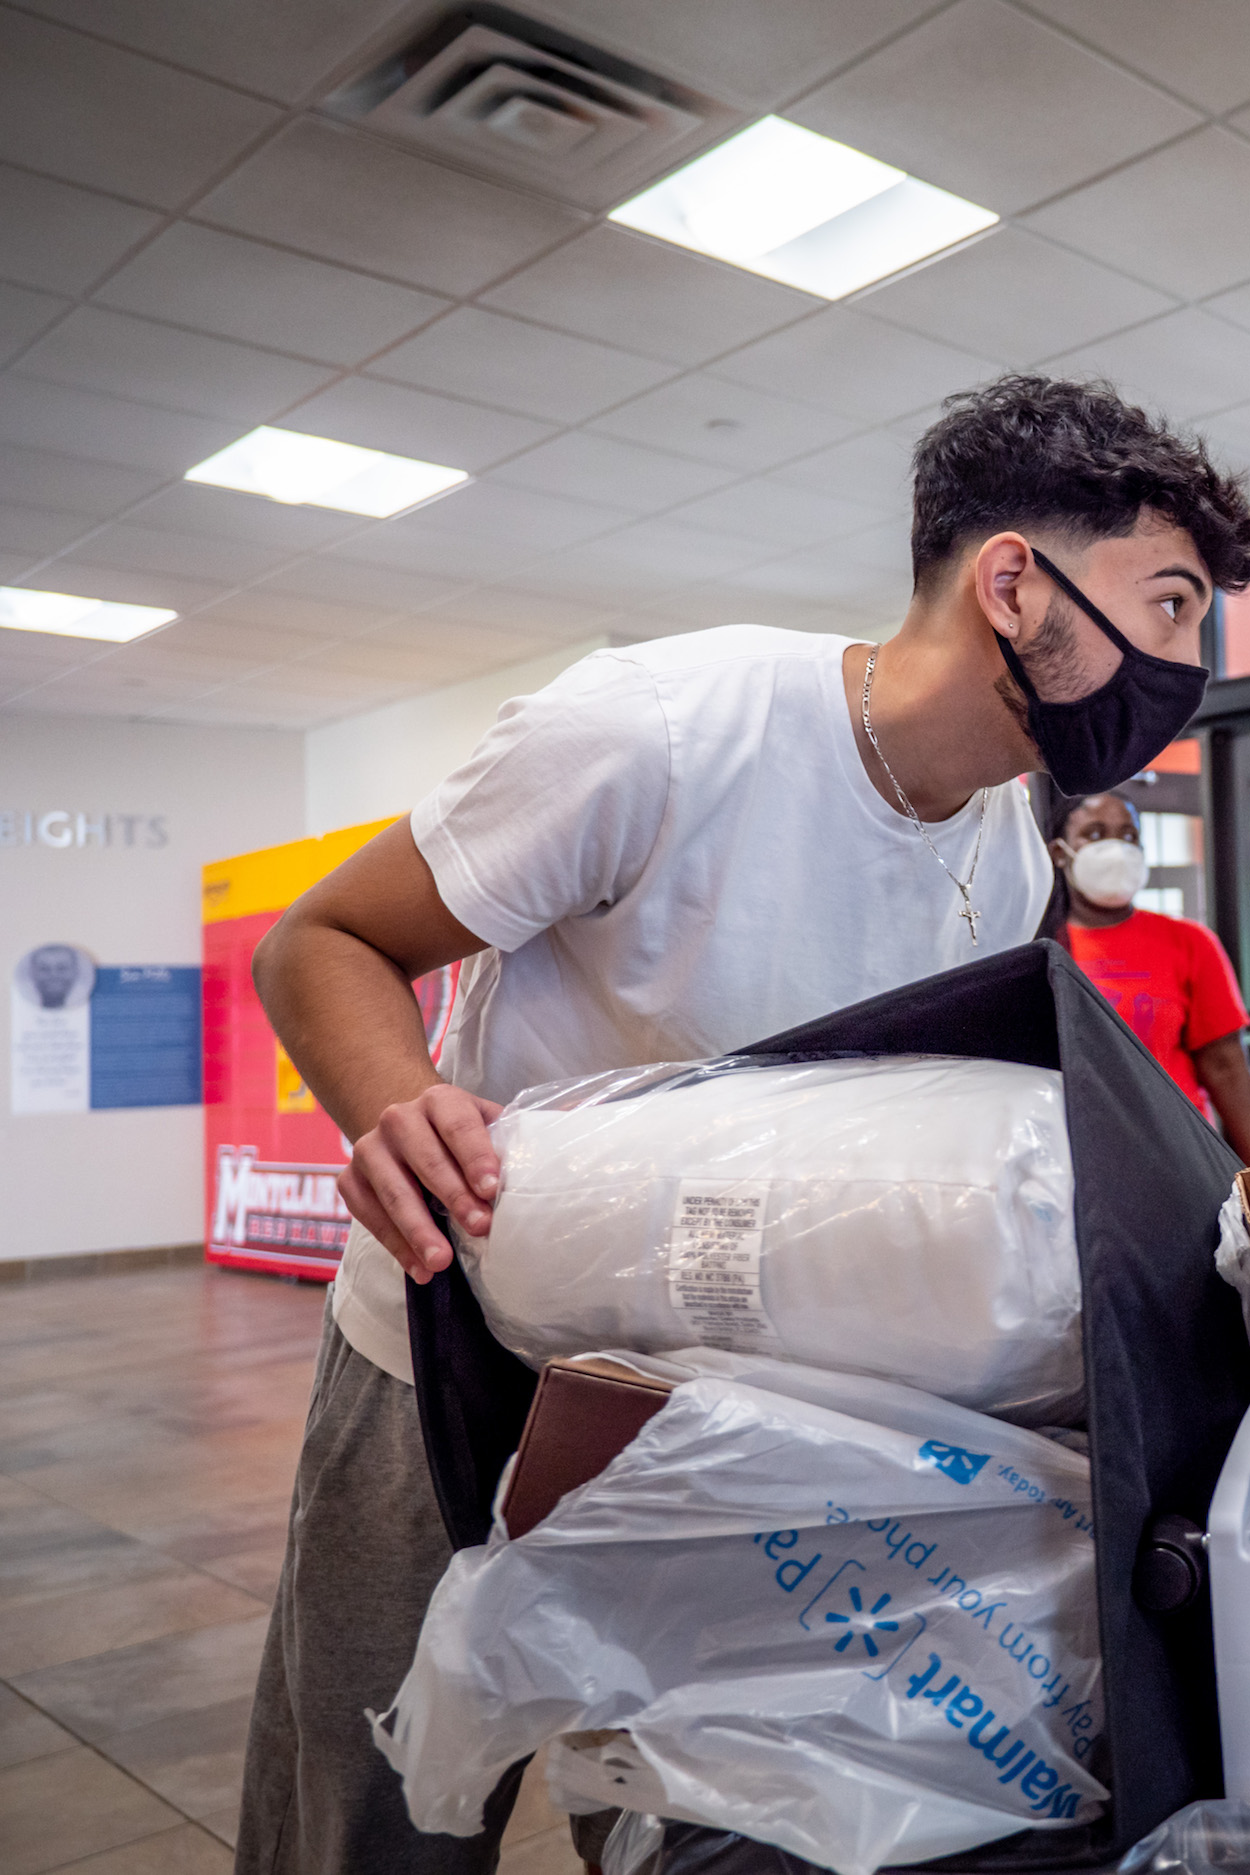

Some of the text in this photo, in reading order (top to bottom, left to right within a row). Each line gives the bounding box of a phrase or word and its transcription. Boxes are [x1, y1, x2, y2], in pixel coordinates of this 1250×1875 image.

[0, 810, 169, 850] EIGHTS
[998, 1464, 1046, 1503] today.
[927, 1567, 1007, 1630] your
[753, 1529, 1083, 1819] Walmart Pa
[998, 1622, 1070, 1708] from
[1061, 1700, 1095, 1760] Pay
